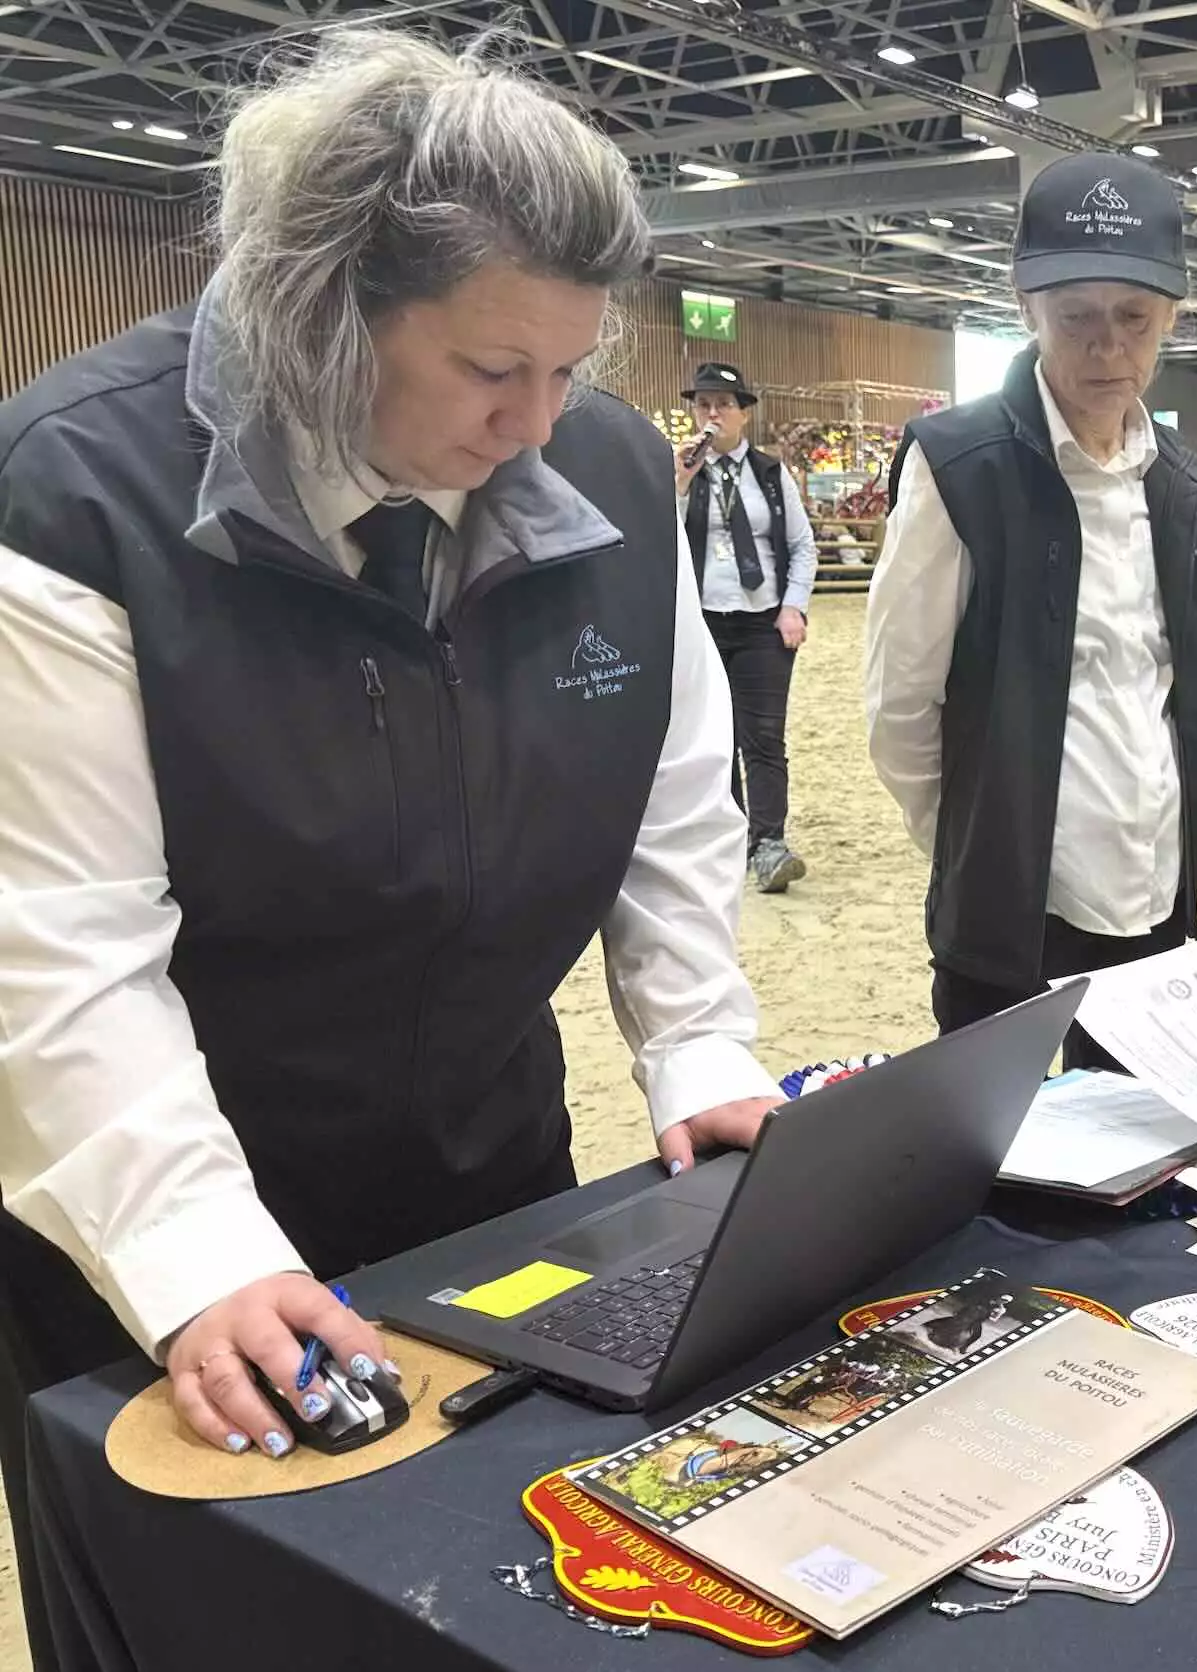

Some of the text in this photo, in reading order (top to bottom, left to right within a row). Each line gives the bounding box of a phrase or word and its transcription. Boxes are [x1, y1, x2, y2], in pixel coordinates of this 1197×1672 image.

[555, 675, 588, 690] Races
[1093, 1359, 1140, 1381] RACES
[1044, 1370, 1128, 1408] DU POITOU
[544, 1475, 620, 1539] AGRICOLE
[1035, 1527, 1113, 1561] PARIS
[1066, 1516, 1119, 1543] Jury
[1137, 1505, 1162, 1567] Ministère
[612, 1529, 694, 1585] GÉNÉRAL
[1049, 1551, 1141, 1588] CONCOURS
[688, 1574, 799, 1635] CONCOURS
